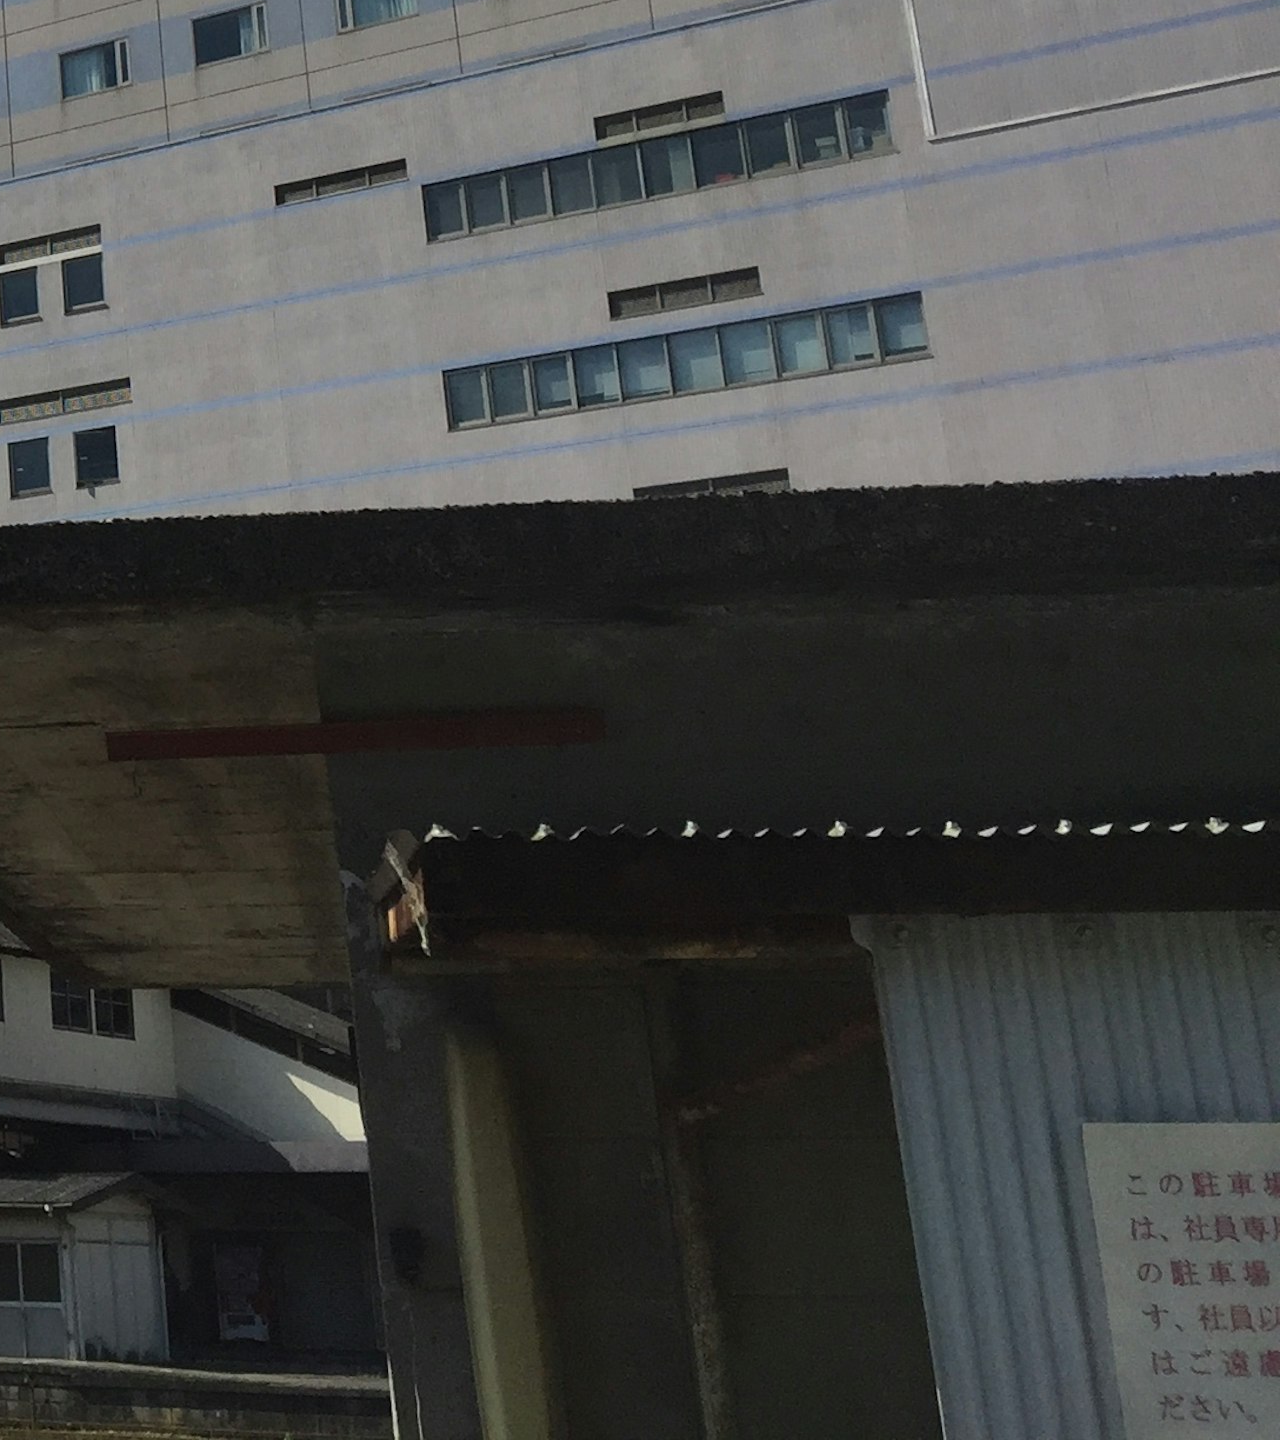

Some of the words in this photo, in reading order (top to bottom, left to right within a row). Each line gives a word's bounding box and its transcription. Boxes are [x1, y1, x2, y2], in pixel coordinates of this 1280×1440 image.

[1138, 1260, 1270, 1287] の駐車場
[1158, 1395, 1257, 1424] ださい。
